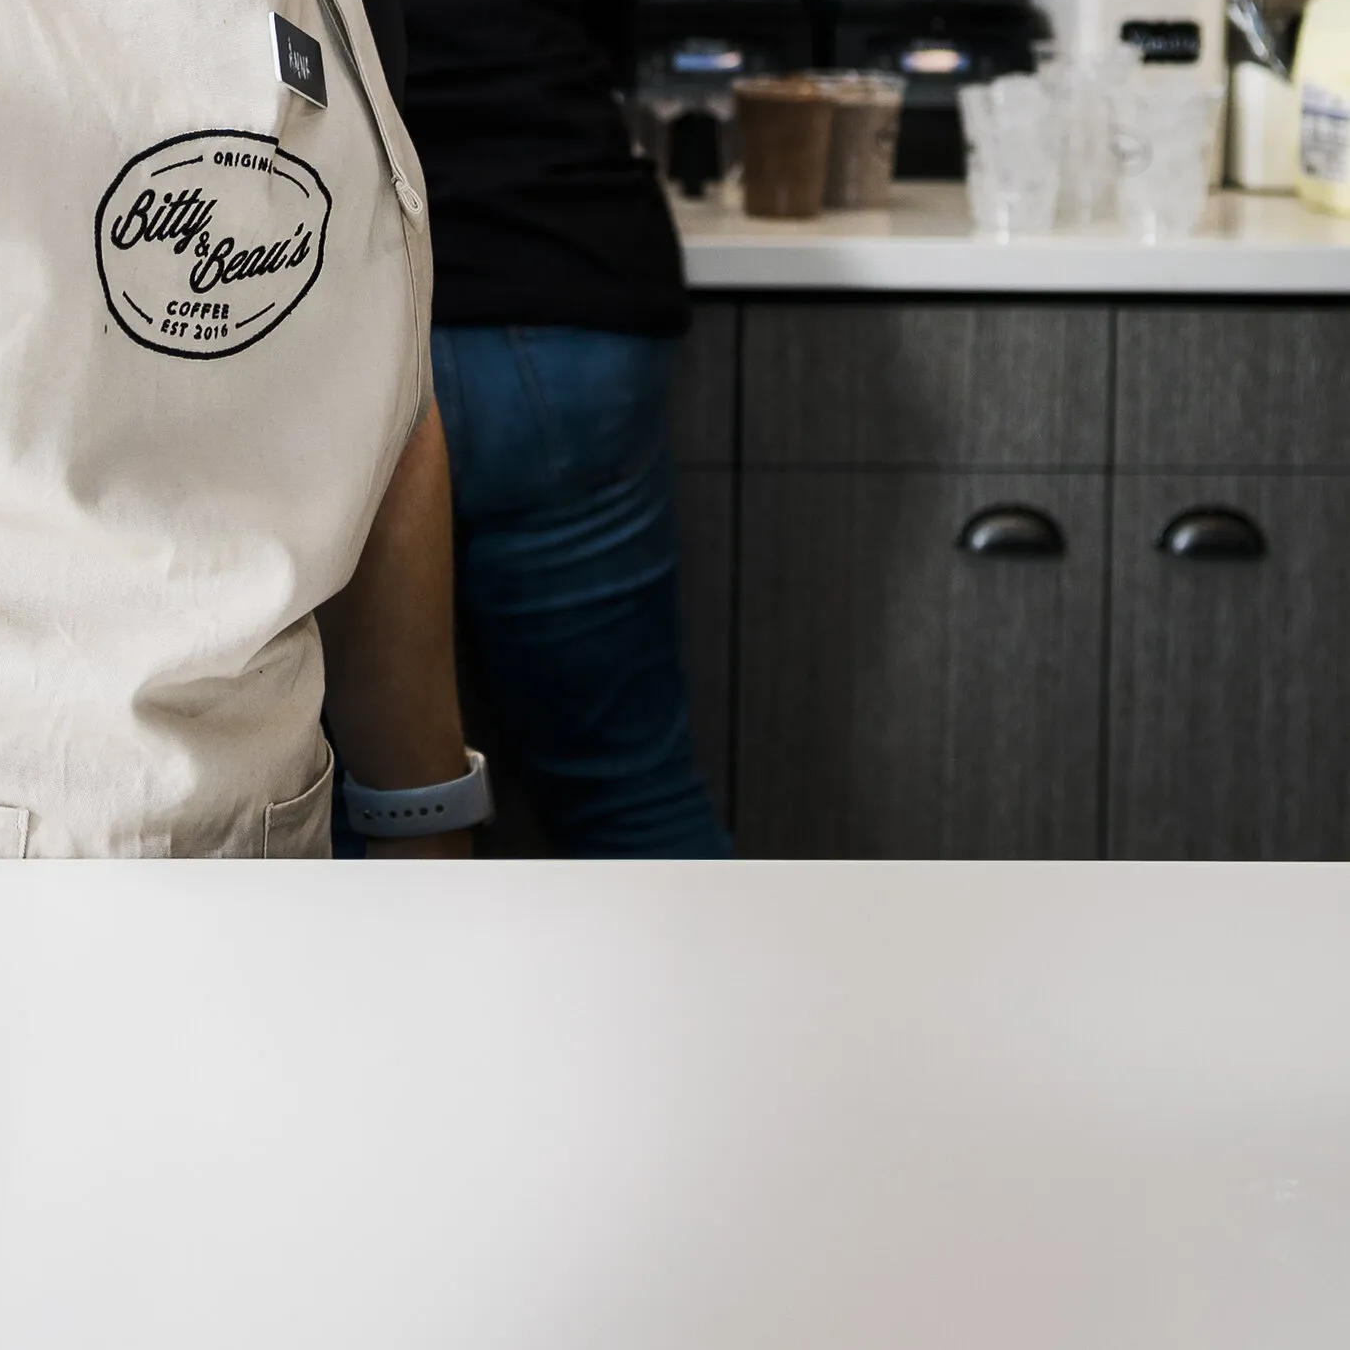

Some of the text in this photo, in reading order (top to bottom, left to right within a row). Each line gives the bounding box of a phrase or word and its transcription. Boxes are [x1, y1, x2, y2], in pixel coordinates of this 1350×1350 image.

[213, 151, 273, 175] ORIGIN
[110, 187, 218, 255] Bitty
[189, 222, 314, 294] & Beau's
[166, 300, 230, 320] COFFEE
[160, 318, 228, 341] EST 2016
